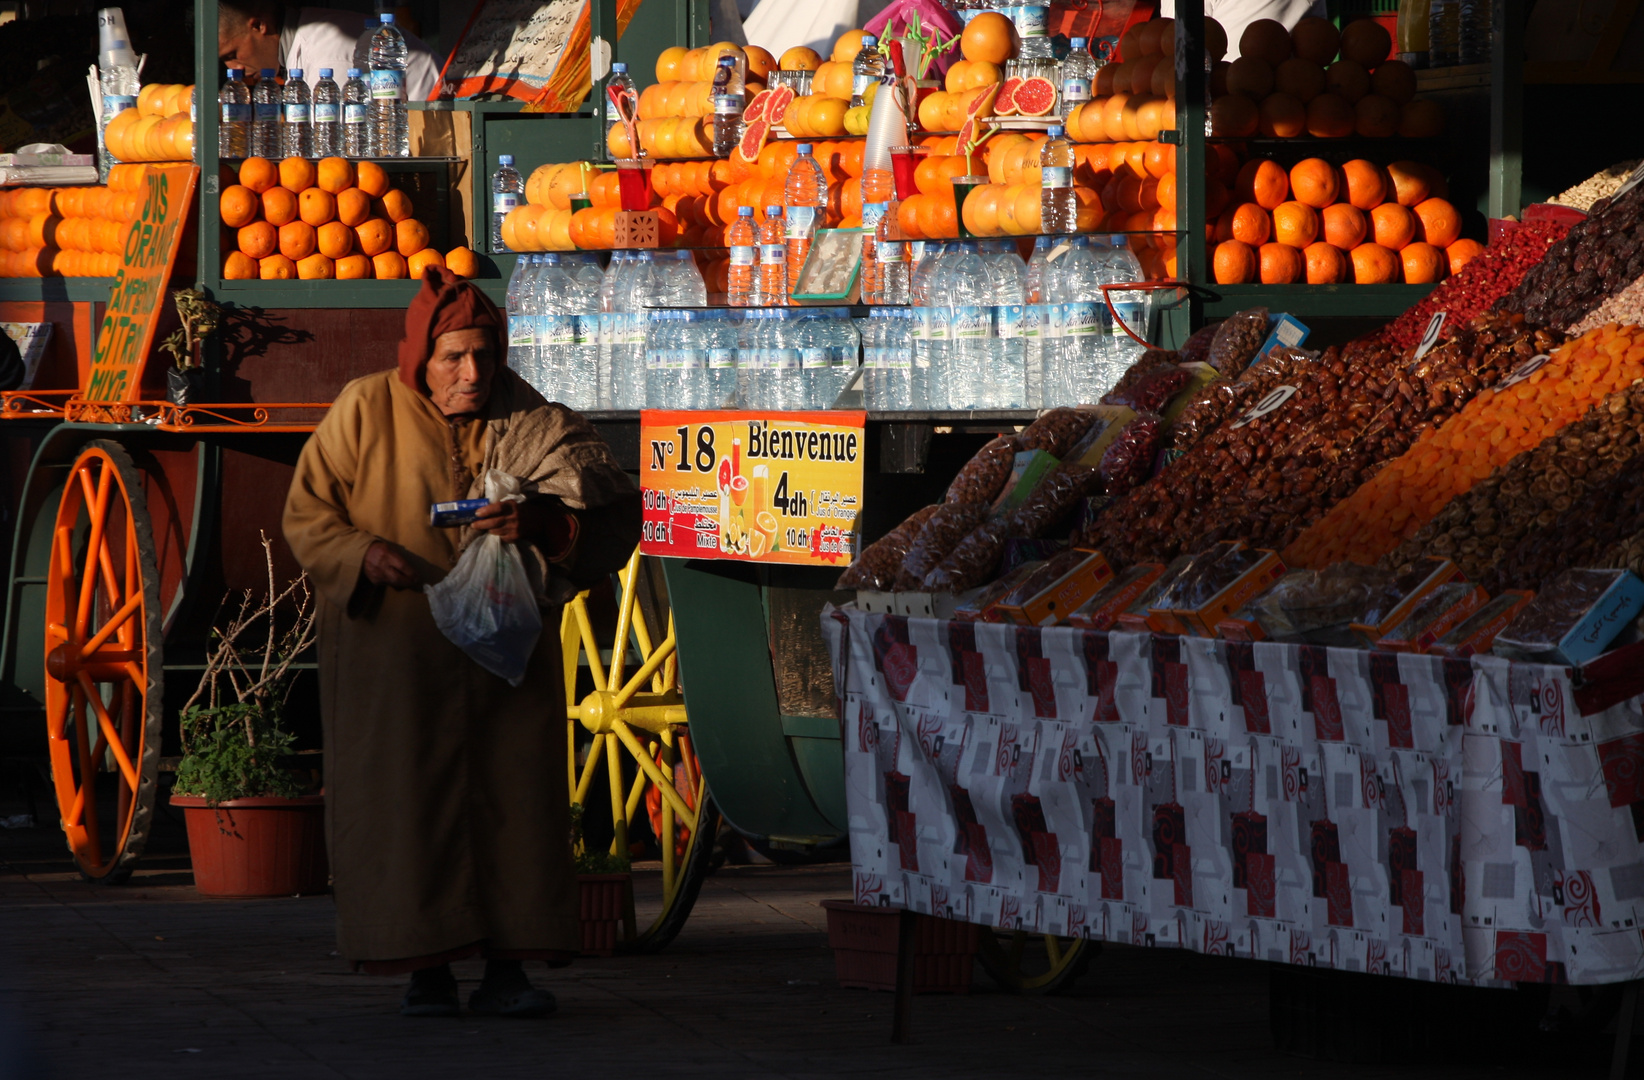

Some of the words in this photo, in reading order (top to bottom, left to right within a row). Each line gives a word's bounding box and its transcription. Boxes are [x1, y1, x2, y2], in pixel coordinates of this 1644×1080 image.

[676, 425, 716, 473] 18
[747, 419, 857, 463] Bienvenue
[643, 489, 654, 510] 10
[655, 491, 667, 511] dh
[773, 471, 808, 517] 4dh
[674, 504, 682, 514] Jus
[682, 504, 688, 514] de
[688, 503, 718, 515] Pamplemousse
[816, 506, 826, 517] Jus
[833, 506, 857, 521] Oranges
[643, 521, 654, 542] 10
[655, 522, 667, 543] dh
[696, 534, 717, 549] Mixte
[786, 528, 796, 547] 10
[797, 529, 808, 548] dh
[819, 541, 830, 553] Jus
[830, 541, 838, 552] de
